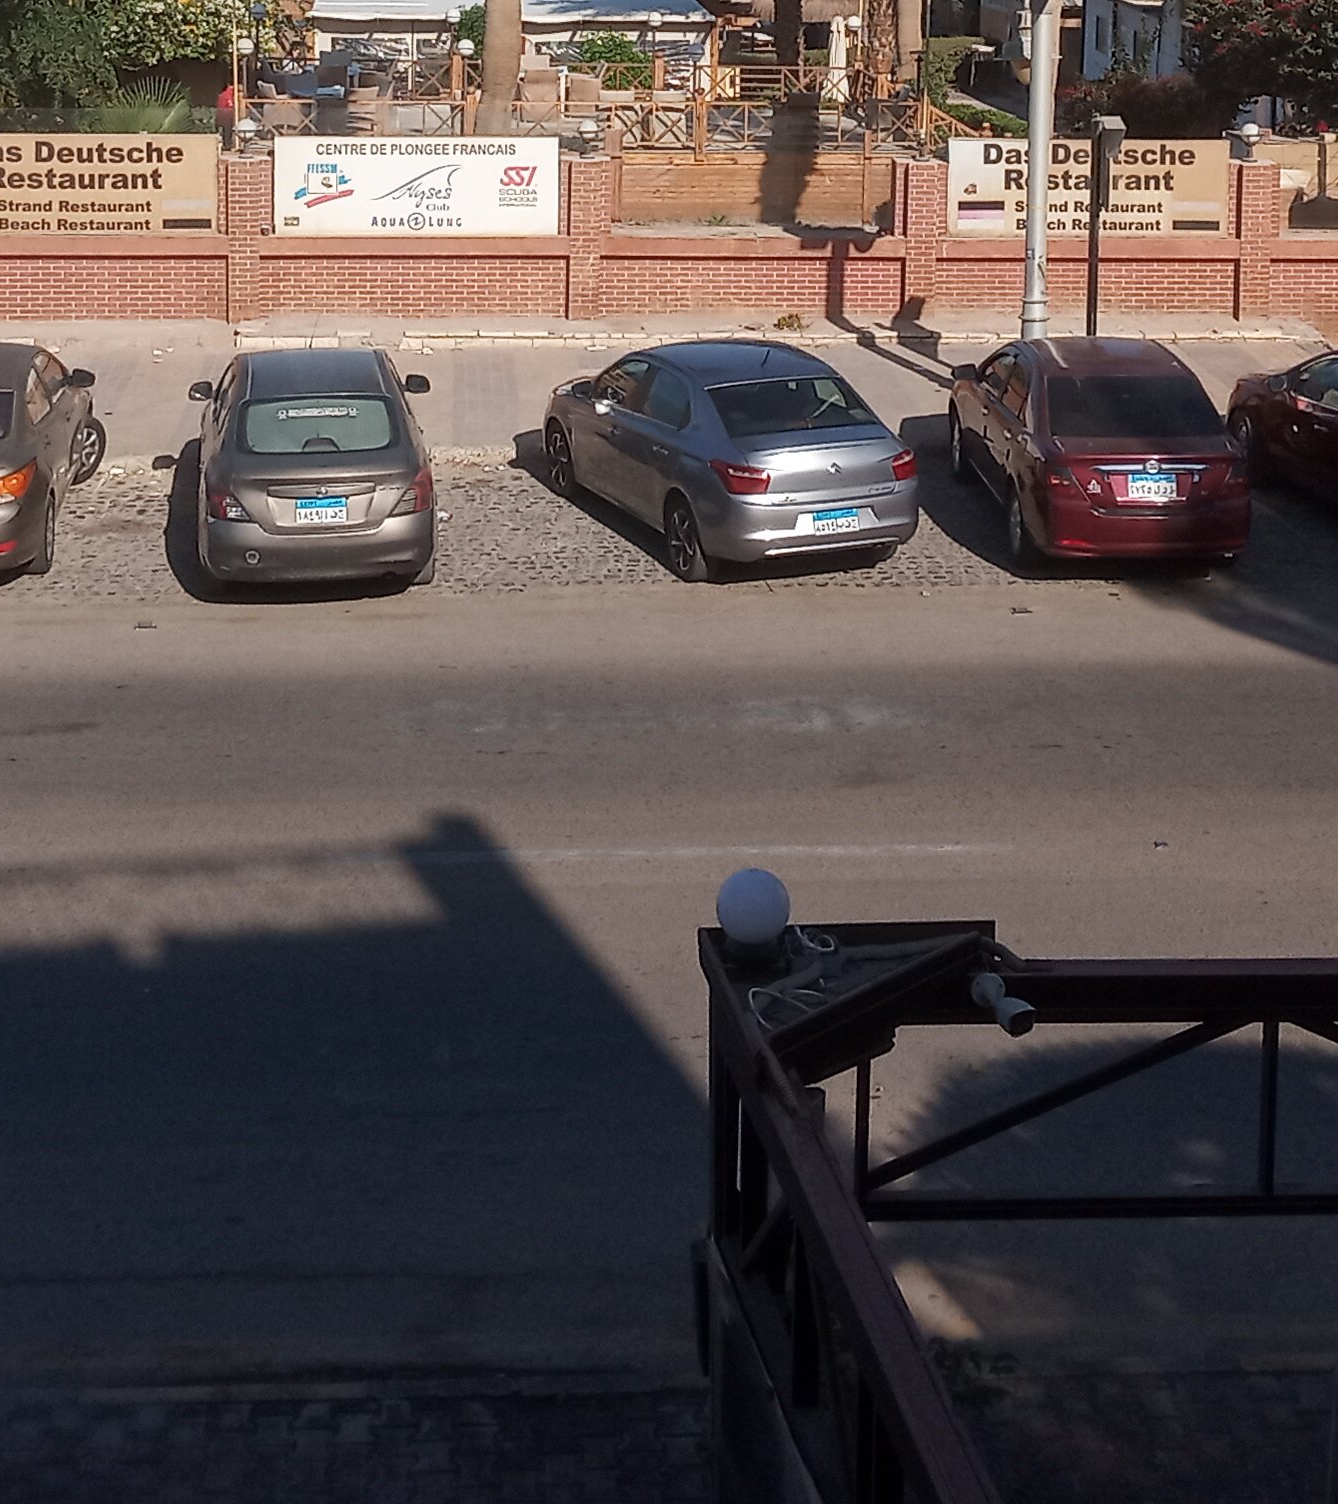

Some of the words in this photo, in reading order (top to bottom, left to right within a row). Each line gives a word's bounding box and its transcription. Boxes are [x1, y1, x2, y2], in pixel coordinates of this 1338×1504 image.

[34, 140, 184, 164] Deutsche
[316, 143, 367, 156] CENTRE
[370, 143, 388, 156] DE
[390, 143, 450, 156] PLONGEE
[452, 143, 517, 156] FRANCAIS
[1052, 143, 1196, 165] Detsche
[499, 166, 538, 186] SSI
[1004, 169, 1174, 191] Rstarant
[58, 200, 153, 213] Restaurant
[57, 218, 152, 231] Restaurant
